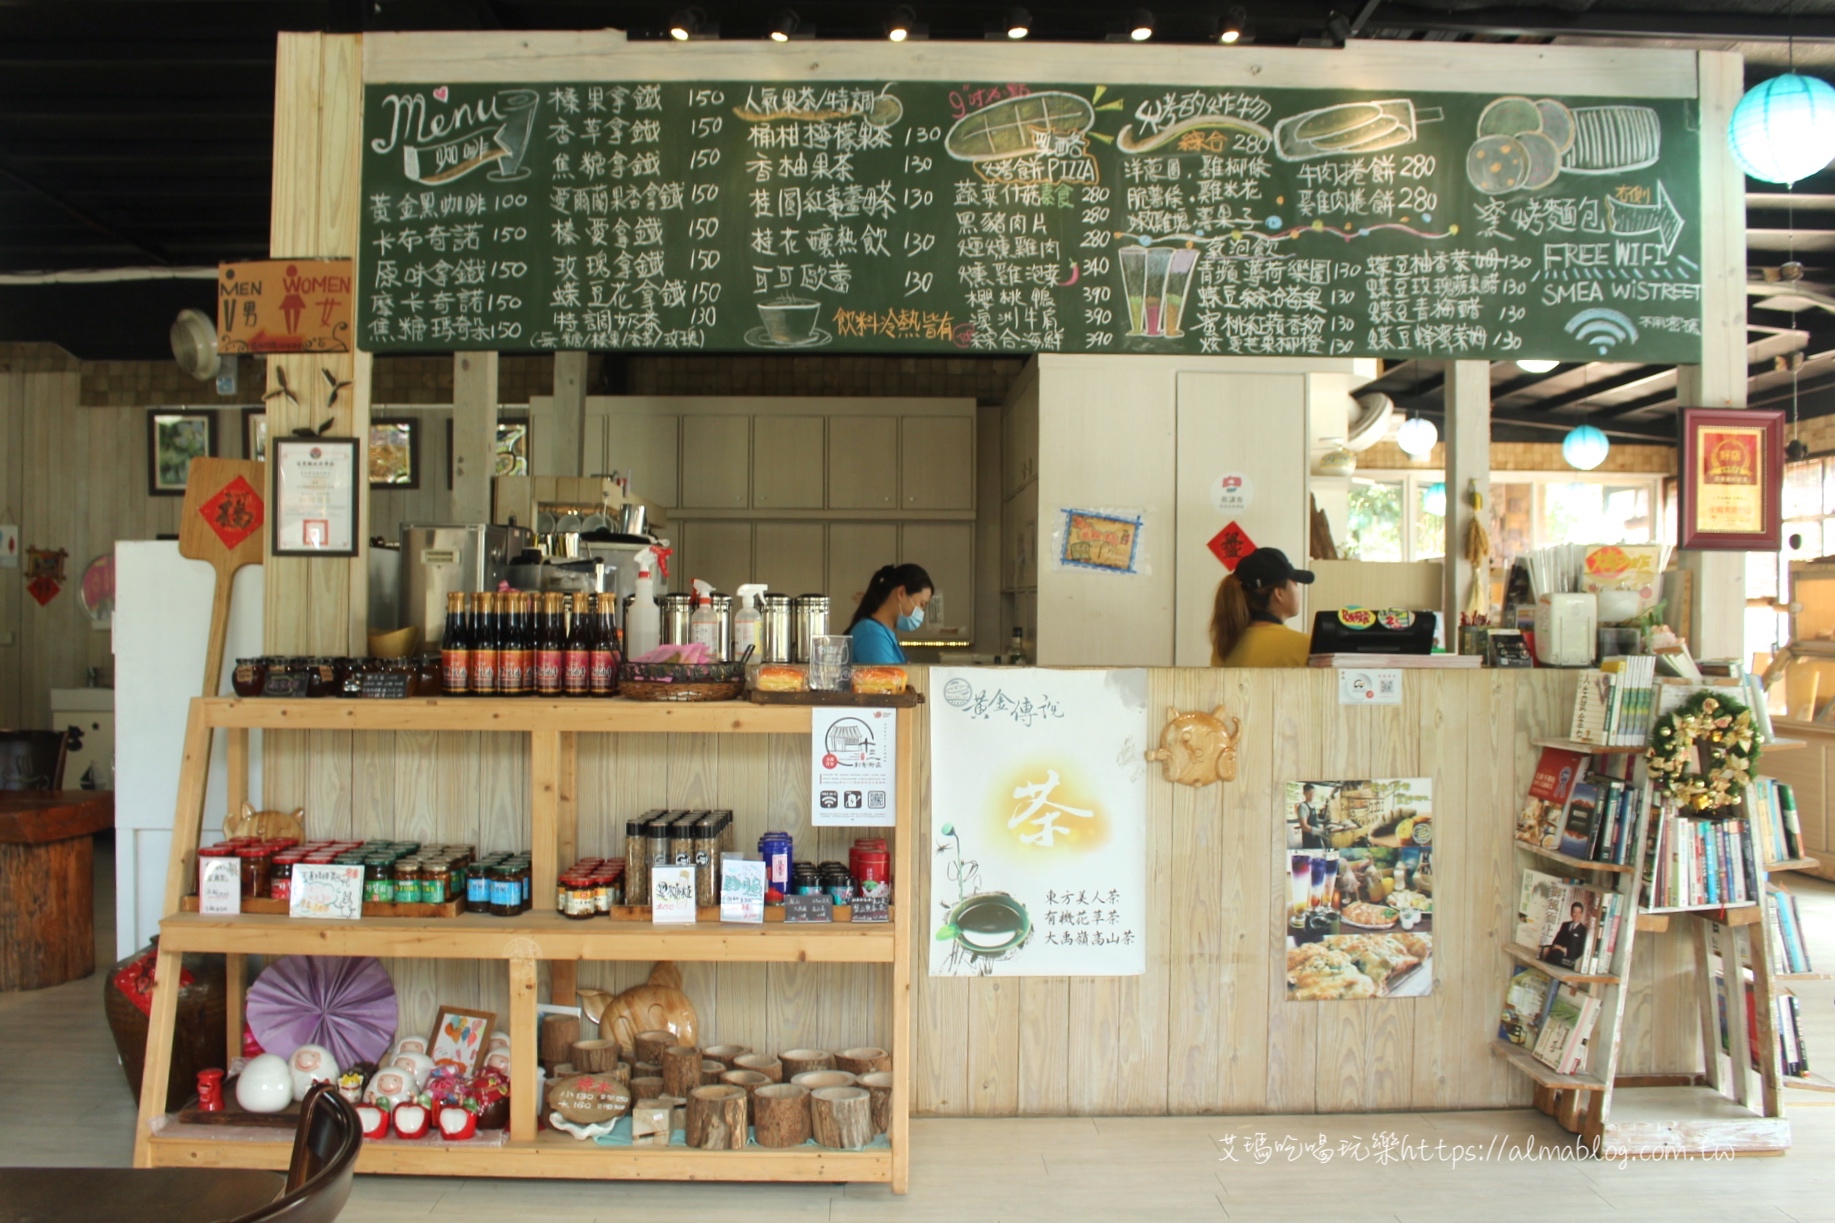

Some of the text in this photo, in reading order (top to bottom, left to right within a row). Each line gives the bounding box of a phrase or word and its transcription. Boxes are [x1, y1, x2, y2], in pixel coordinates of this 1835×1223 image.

[547, 84, 725, 114] 榛果拿鐵 150
[1134, 90, 1272, 137] 烤的炸物
[371, 94, 506, 155] Menu
[547, 116, 724, 146] 香草拿鐵 150
[747, 120, 941, 151] 桶柑檸檬果茶 130
[435, 137, 489, 169] 咖啡
[1177, 129, 1271, 155] 綜合 280
[552, 149, 722, 181] 焦糖拿鐵 150
[746, 151, 933, 182] 香柚果茶 130
[981, 157, 1096, 184] 烤餅 PIZZA
[1296, 153, 1437, 189] 牛肉捲餅 280
[369, 193, 528, 224] 黃金黑咖啡 100
[690, 184, 719, 203] 150
[748, 179, 934, 222] 桂圓紅棗薑母茶 130
[1081, 186, 1110, 205] 280
[1297, 186, 1438, 218] 雞肉捲餅 280
[1615, 185, 1651, 205] 右側
[688, 218, 719, 238] 150
[955, 206, 1111, 236] 黑豬肉片 280
[1472, 196, 1606, 241] 窯烤麵包
[372, 222, 527, 257] 卡布奇諾 150
[751, 223, 936, 259] 桂花釀熱飲 130
[957, 229, 1112, 261] 煙燻雞肉 280
[1205, 237, 1284, 259] 氣泡飲
[1544, 239, 1669, 270] FREE WIFI
[376, 259, 528, 289] 原味拿鐵 150
[553, 249, 721, 282] 玫瑰拿鐵 150
[958, 256, 1110, 288] 燻雞泡菜 340
[1197, 257, 1362, 287] 青蘋薄荷樂園 130
[1365, 247, 1532, 276] 蝶豆柚香萊姆 130
[220, 280, 263, 297] MEN
[282, 275, 352, 295] WOMEN
[752, 260, 934, 297] 可可歐蕾 130
[1365, 273, 1526, 300] 蝶豆玫瑰蘋果醋 130
[1541, 279, 1703, 306] SMEA WiSTREET
[486, 293, 523, 314] 150
[551, 279, 722, 311] 蝶豆花拿鐵 150
[964, 286, 1112, 311] 櫻桃鴨 390
[1197, 284, 1356, 313] 蝶豆綜合莓果 130
[243, 300, 258, 328] 男
[553, 306, 717, 333] 特調奶茶 130
[832, 306, 954, 342] 飲料冷熱皆有
[969, 306, 1113, 332] 澳洲牛肩 390
[1331, 316, 1355, 332] 130
[1367, 297, 1526, 324] 蝶豆青梅醋 130
[368, 315, 523, 345] 焦糖瑪奇朵 150
[970, 327, 1114, 351] 綜合海鮮 390
[1367, 321, 1522, 354] 蝶豆蜂蜜萊姆 130
[1638, 315, 1703, 337] 不用密碼
[1329, 338, 1355, 356] 130
[962, 688, 1065, 728] 黃金傳說
[1007, 768, 1095, 848] 茶
[1044, 888, 1121, 905] 東方美人茶
[1044, 909, 1121, 926] 有機花草茶
[1044, 929, 1136, 947] 大禹嶺高山茶
[573, 1101, 592, 1110] 160
[576, 1091, 595, 1100] 130
